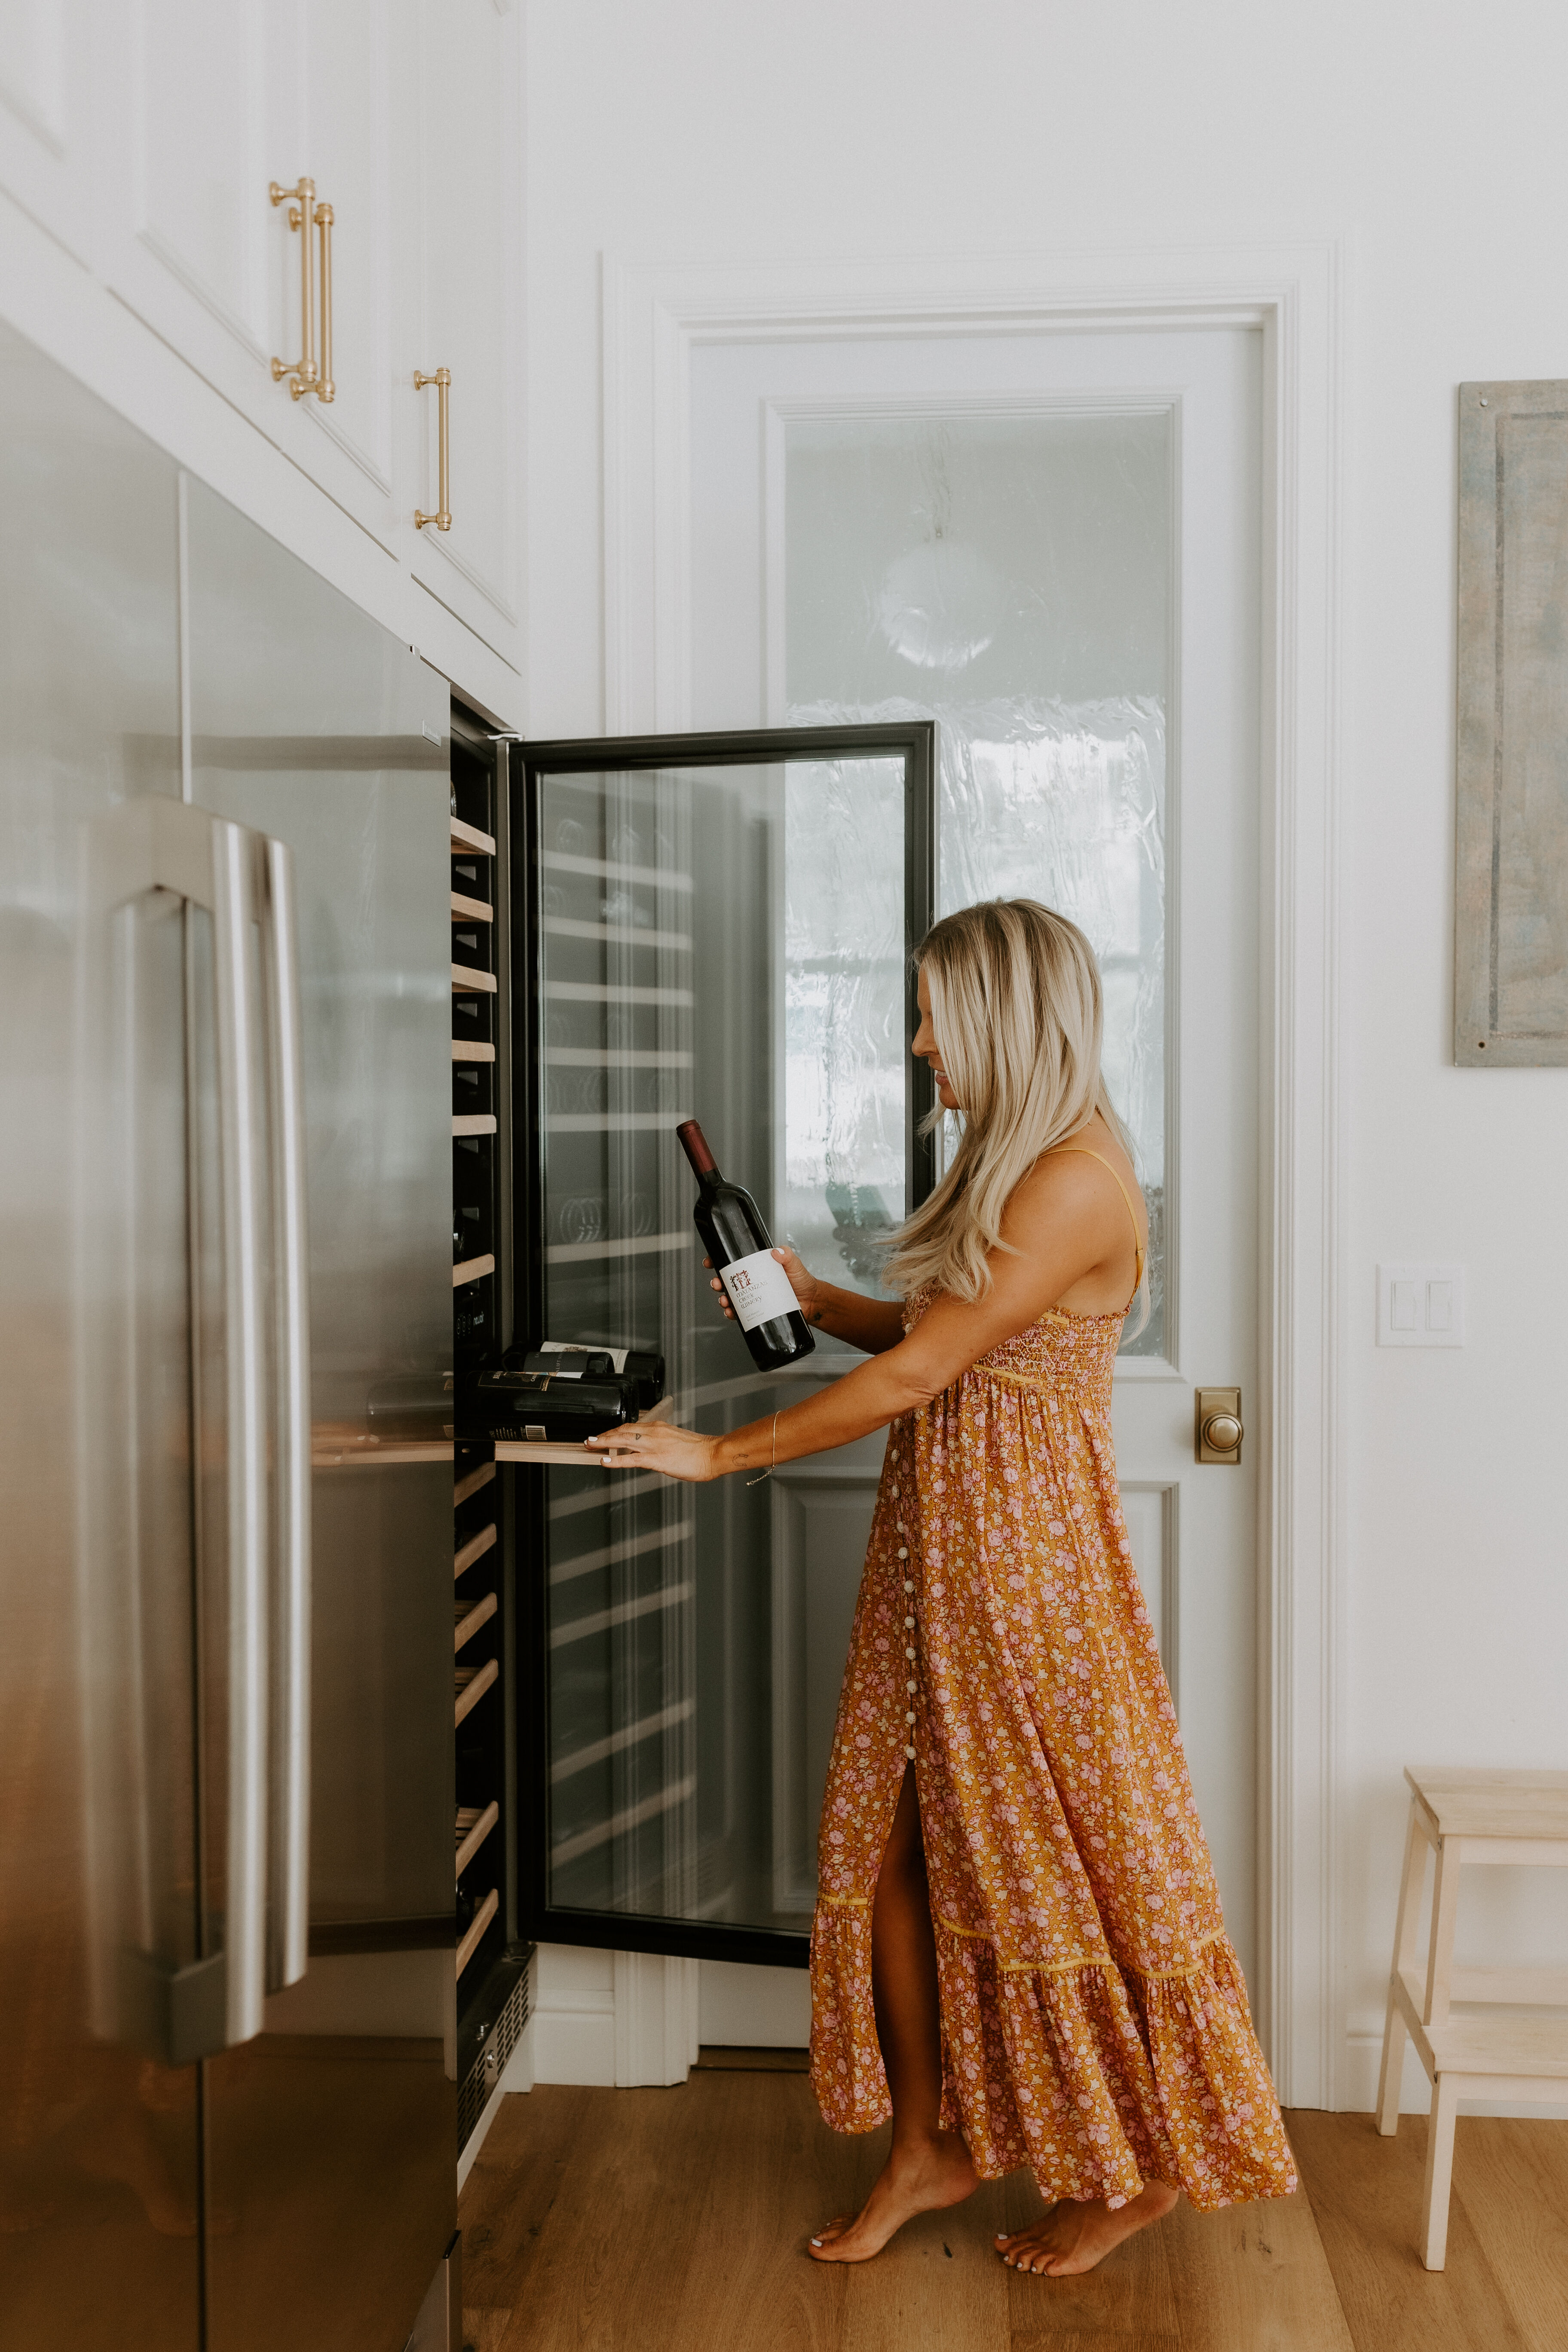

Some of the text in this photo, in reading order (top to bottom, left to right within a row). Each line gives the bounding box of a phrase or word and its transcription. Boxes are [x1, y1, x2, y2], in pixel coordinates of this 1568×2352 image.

[736, 1280, 768, 1298] MATANZAS
[738, 1293, 754, 1303] CREEK
[741, 1295, 762, 1309] WINERY
